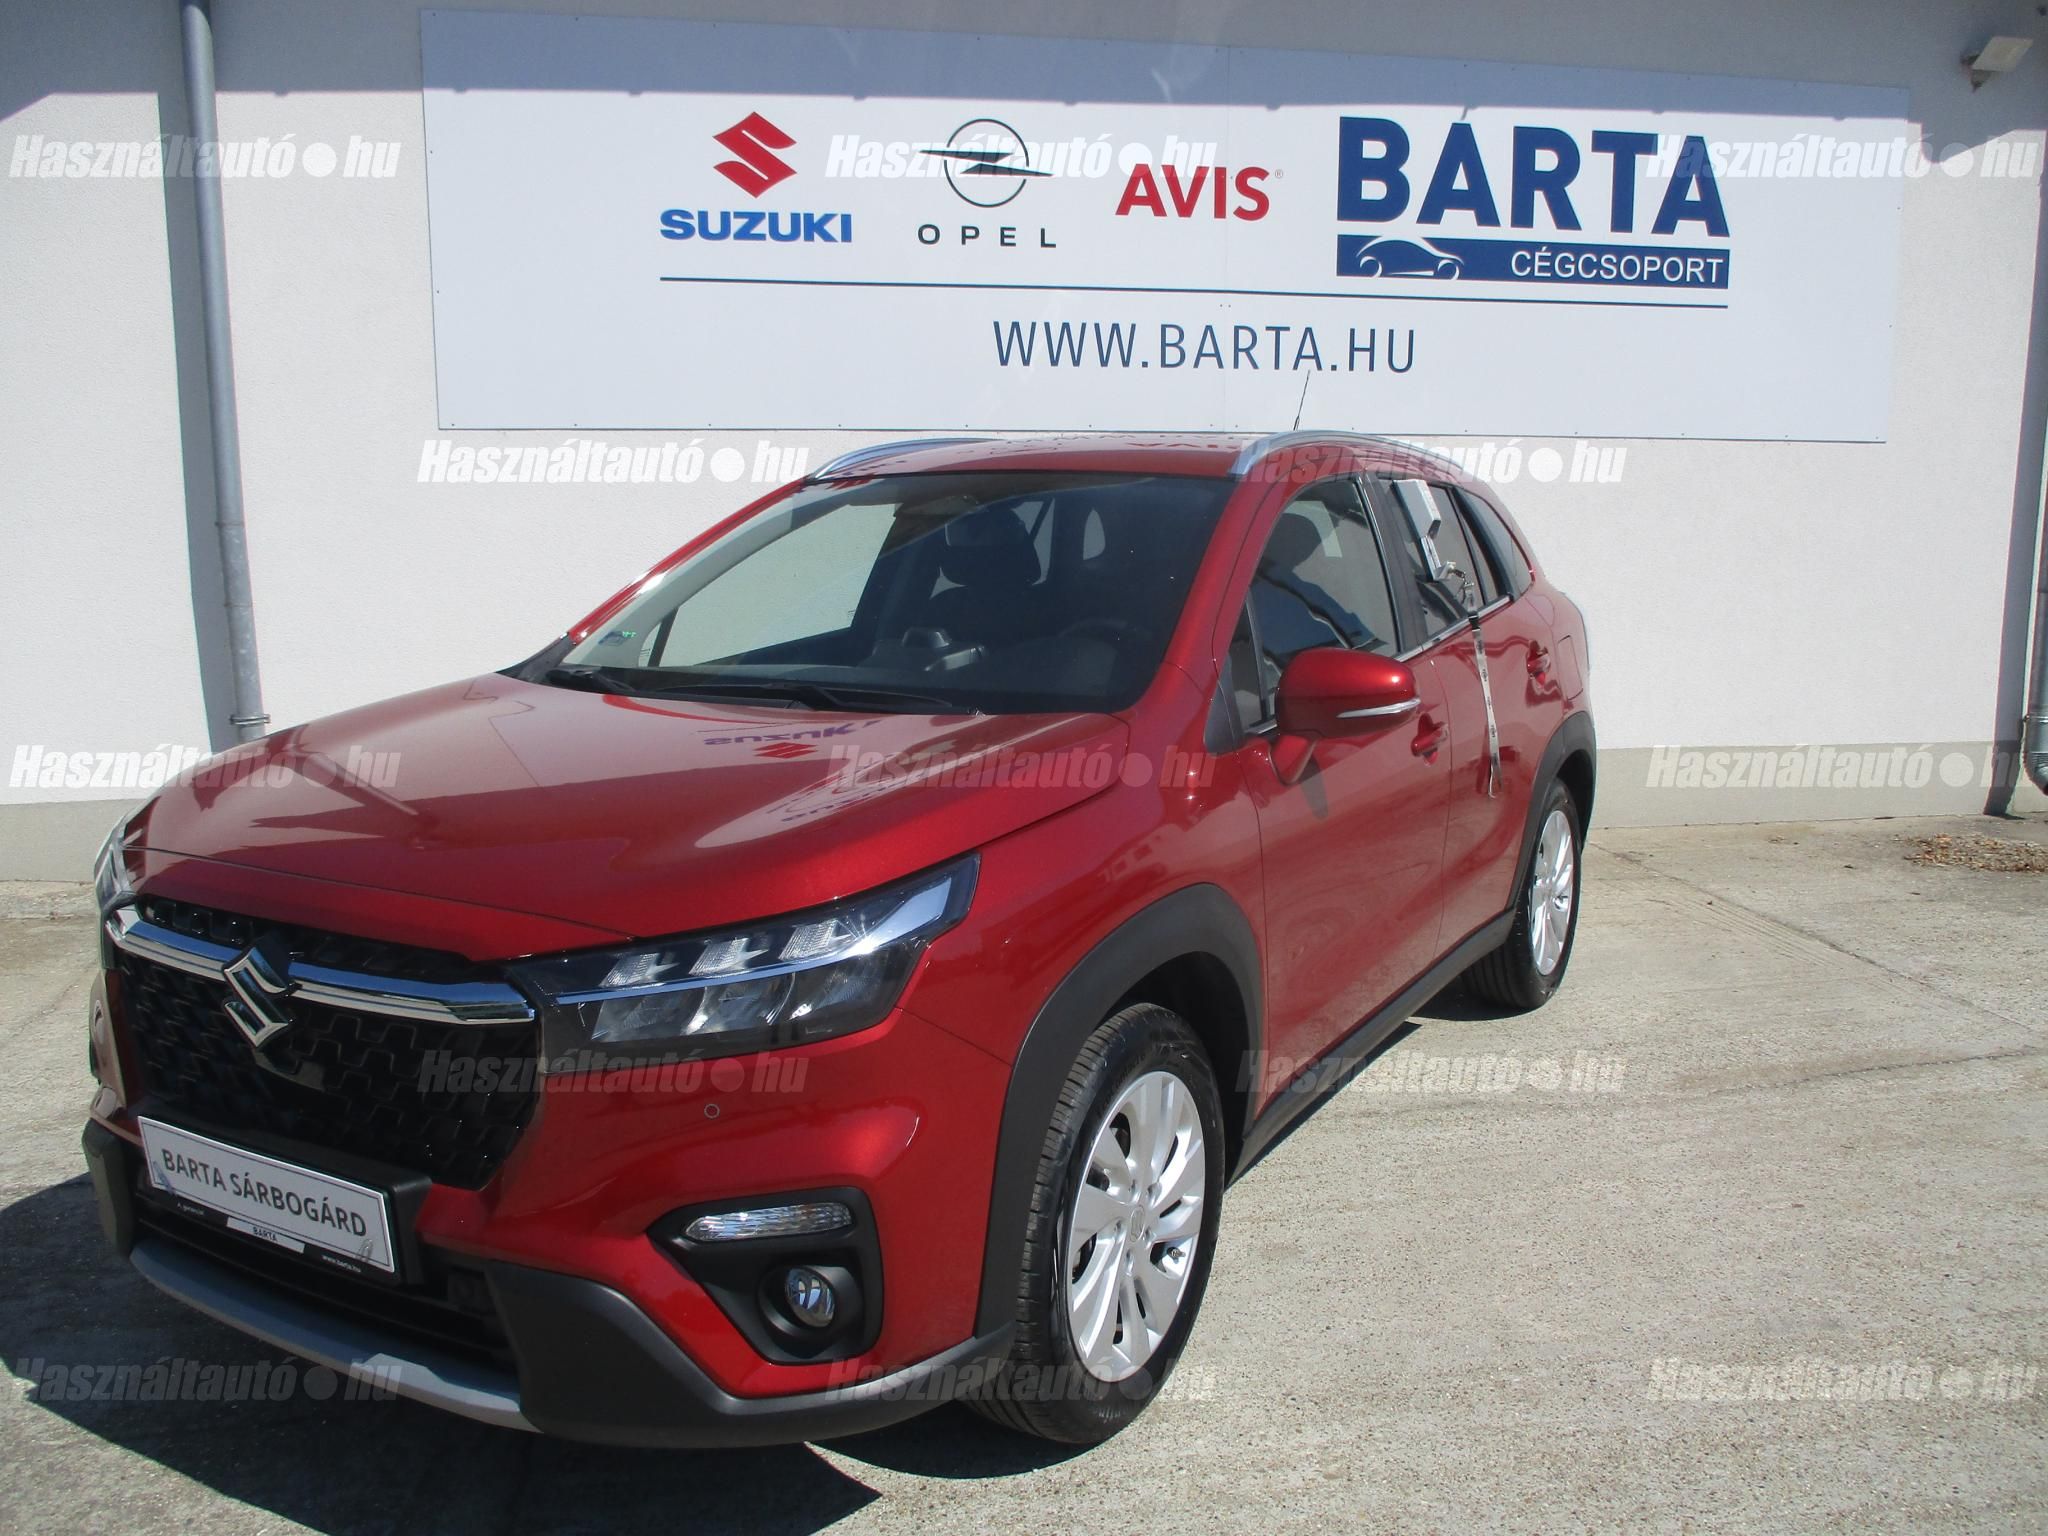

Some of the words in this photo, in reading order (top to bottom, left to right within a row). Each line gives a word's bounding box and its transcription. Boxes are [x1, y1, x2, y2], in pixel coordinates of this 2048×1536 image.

[1114, 164, 1271, 220] AVIS
[1337, 116, 1731, 238] BARTA
[660, 209, 852, 244] SUZUKI
[918, 223, 1057, 249] OPEL
[1510, 245, 1724, 284] CÉGCSOPORT
[993, 321, 1416, 373] WWW.BARTA.HU
[161, 1148, 227, 1193] BARTA
[229, 1172, 367, 1237] SÁRBOGÁRD
